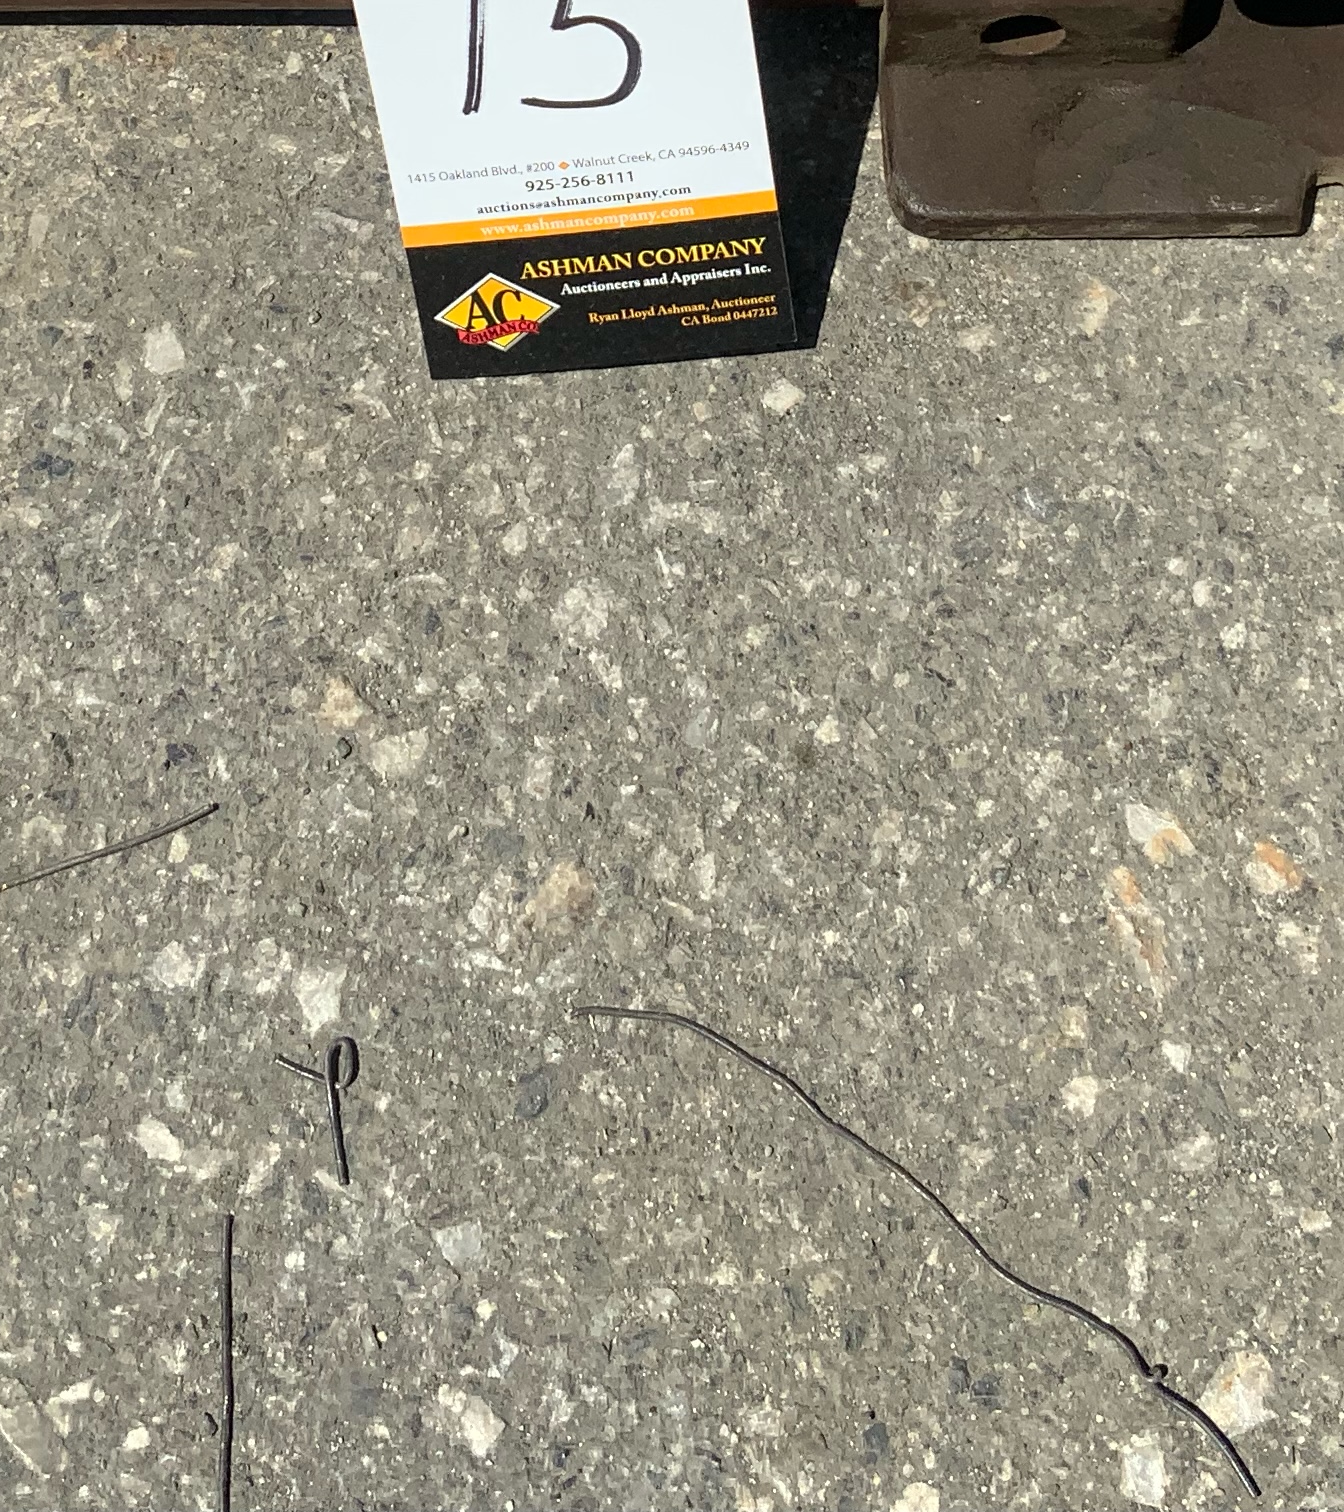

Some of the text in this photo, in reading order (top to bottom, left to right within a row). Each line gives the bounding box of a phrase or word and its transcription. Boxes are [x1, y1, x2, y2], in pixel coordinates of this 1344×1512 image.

[407, 140, 750, 184] 1415 Oakland Blvd., #200 Walnut Creek, CA 94596-4349
[525, 170, 635, 192] 925-256-8111
[477, 186, 692, 215] auctions@ashmancompany.com
[480, 205, 695, 236] www.ashmancompany.com
[520, 236, 767, 280] ASHMAN COMPANY
[560, 262, 772, 296] Auctioneers and Appraisers Inc.
[465, 289, 525, 332] AC
[588, 294, 777, 326] Ryan Lloyd Ashman, Auctioneer
[680, 305, 779, 327] CA Bond 0447212
[462, 322, 517, 344] ASHMAN
